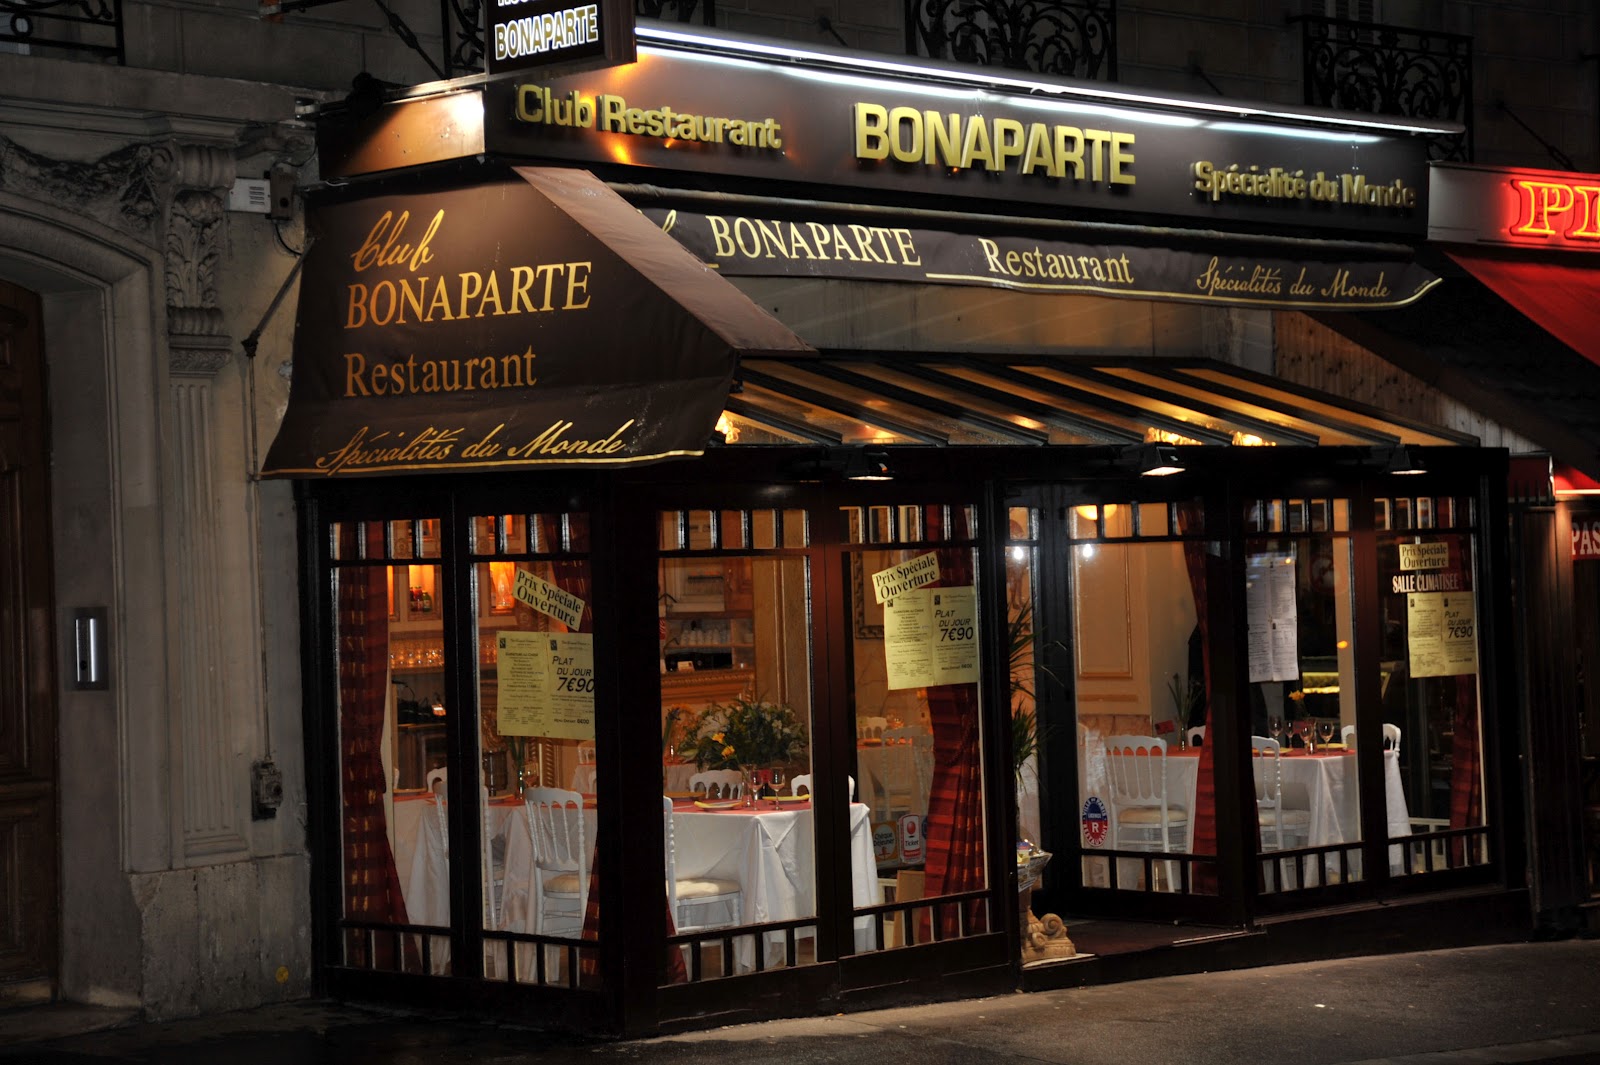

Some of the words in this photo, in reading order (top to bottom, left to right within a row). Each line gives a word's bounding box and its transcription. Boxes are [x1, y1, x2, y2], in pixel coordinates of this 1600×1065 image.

[494, 4, 599, 61] BONAPARTE
[516, 84, 593, 129] Club
[597, 94, 782, 149] Restaurant
[855, 102, 1136, 185] BONAPARTE
[1195, 161, 1306, 201] Spécialité
[1310, 171, 1338, 201] du
[1341, 173, 1416, 208] Monde
[351, 209, 444, 272] Club
[705, 215, 921, 267] BONAPARTE
[978, 237, 1134, 284] Restaurant
[1196, 256, 1282, 297] Spécialités
[1289, 267, 1315, 296] du
[1321, 268, 1390, 298] Monde
[344, 261, 592, 329] BONAPARTE
[344, 344, 537, 398] Restaurant
[316, 425, 465, 476] Spécialités
[461, 423, 504, 458] du
[508, 419, 634, 458] Monde
[1402, 545, 1416, 557] Prix
[1417, 544, 1447, 558] Spéciale
[1403, 557, 1446, 568] Ouverture
[874, 572, 896, 588] Prix
[896, 555, 936, 579] Spéciale
[880, 570, 936, 600] Ouverture
[1392, 574, 1416, 594] SALLE
[517, 571, 537, 591] Prix
[540, 583, 580, 613] Spéciale
[517, 586, 575, 625] Ouverture
[935, 610, 955, 618] PLAT
[939, 619, 950, 627] DU
[951, 618, 971, 627] JOUR
[1448, 626, 1473, 638] 7€90
[940, 627, 974, 642] 7€90
[552, 655, 574, 666] PLAT
[557, 668, 568, 676] DU
[570, 668, 592, 677] JOUR
[557, 677, 595, 693] 7€90
